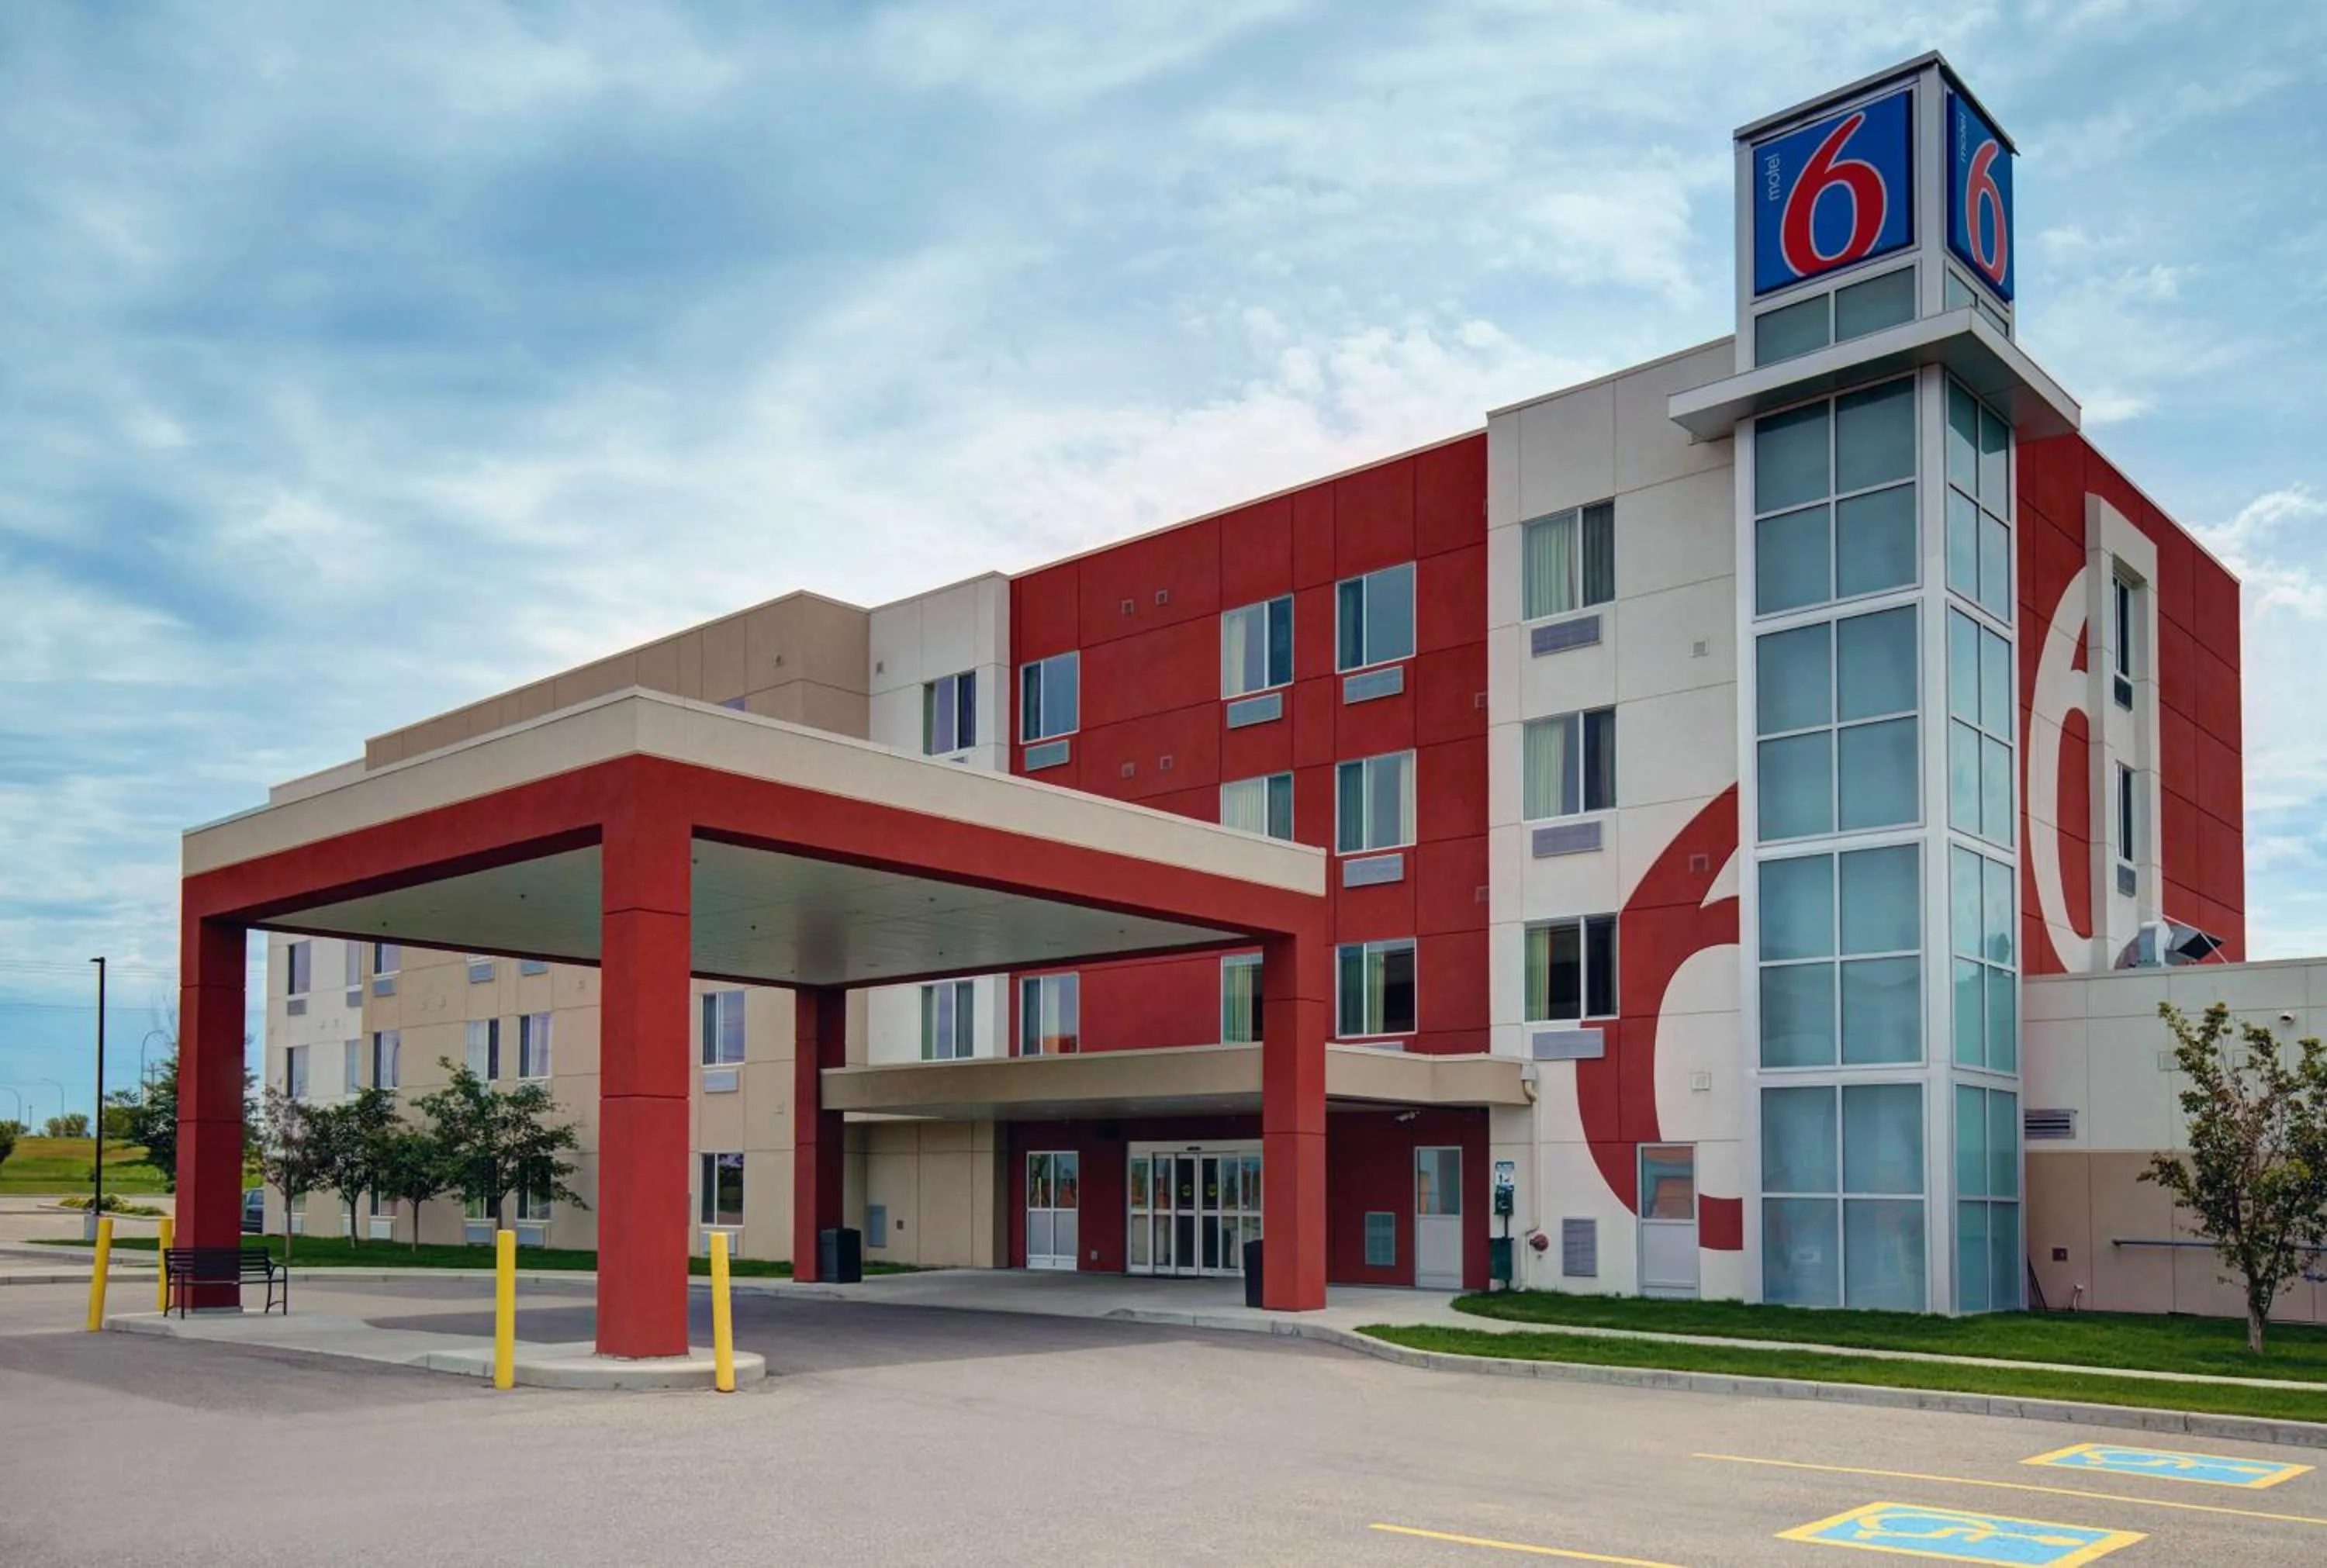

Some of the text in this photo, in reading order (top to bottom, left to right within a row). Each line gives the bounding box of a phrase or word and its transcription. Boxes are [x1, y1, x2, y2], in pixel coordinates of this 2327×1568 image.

[1764, 154, 1780, 201] motel
[1780, 111, 1887, 277] 6
[1966, 140, 2007, 285] 6
